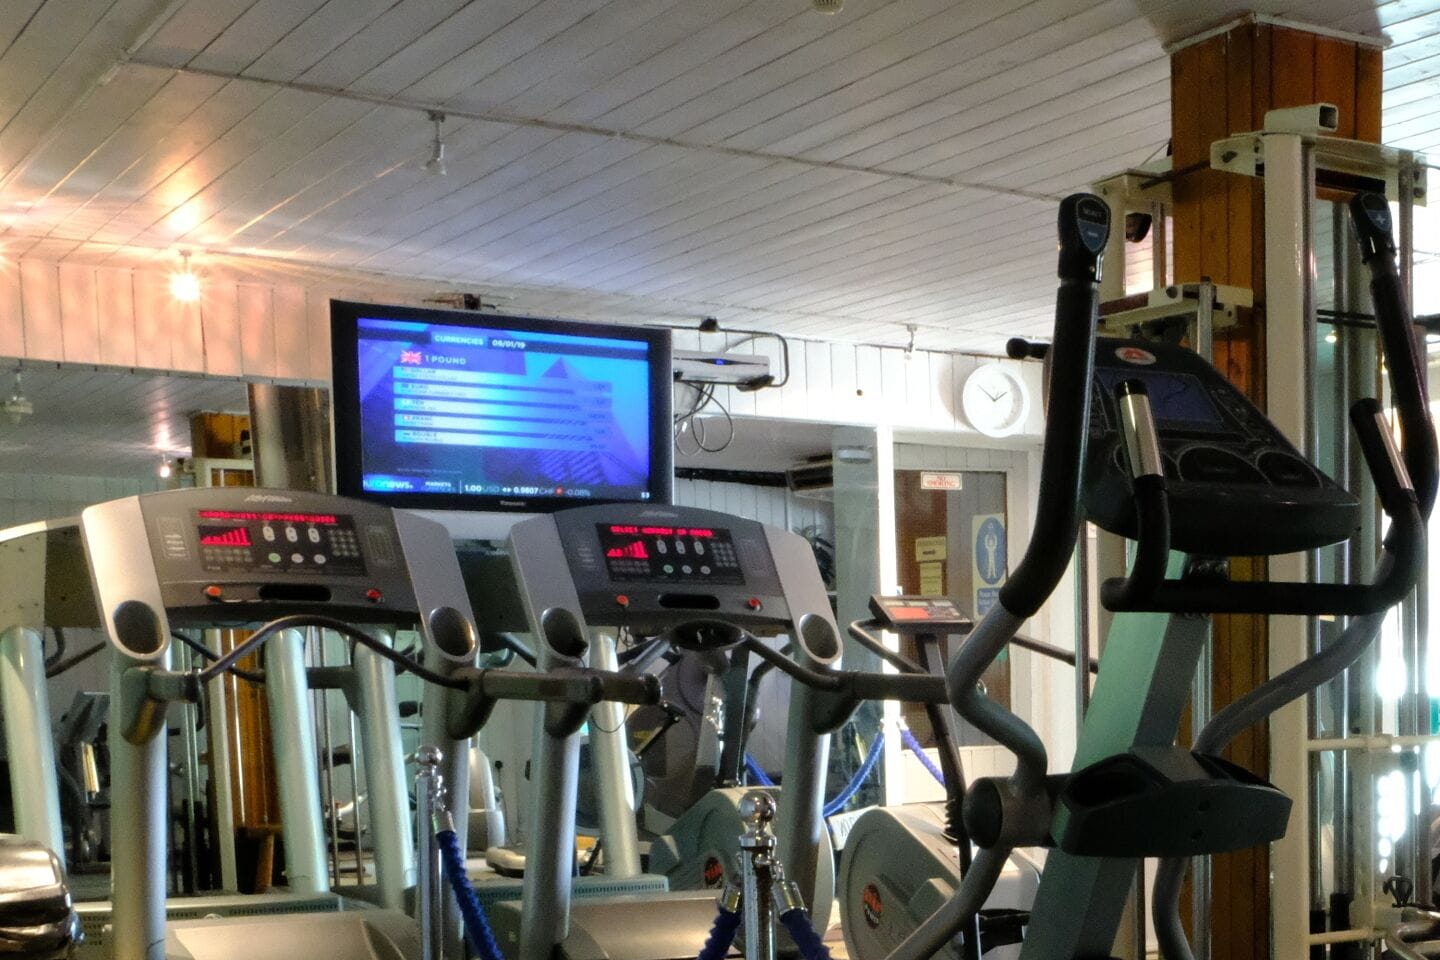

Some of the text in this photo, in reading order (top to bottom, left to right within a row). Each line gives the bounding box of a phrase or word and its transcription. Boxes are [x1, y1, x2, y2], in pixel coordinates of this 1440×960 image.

[434, 334, 485, 346] CURRENCIES
[431, 355, 467, 365] POUND
[464, 484, 481, 492] 1.00
